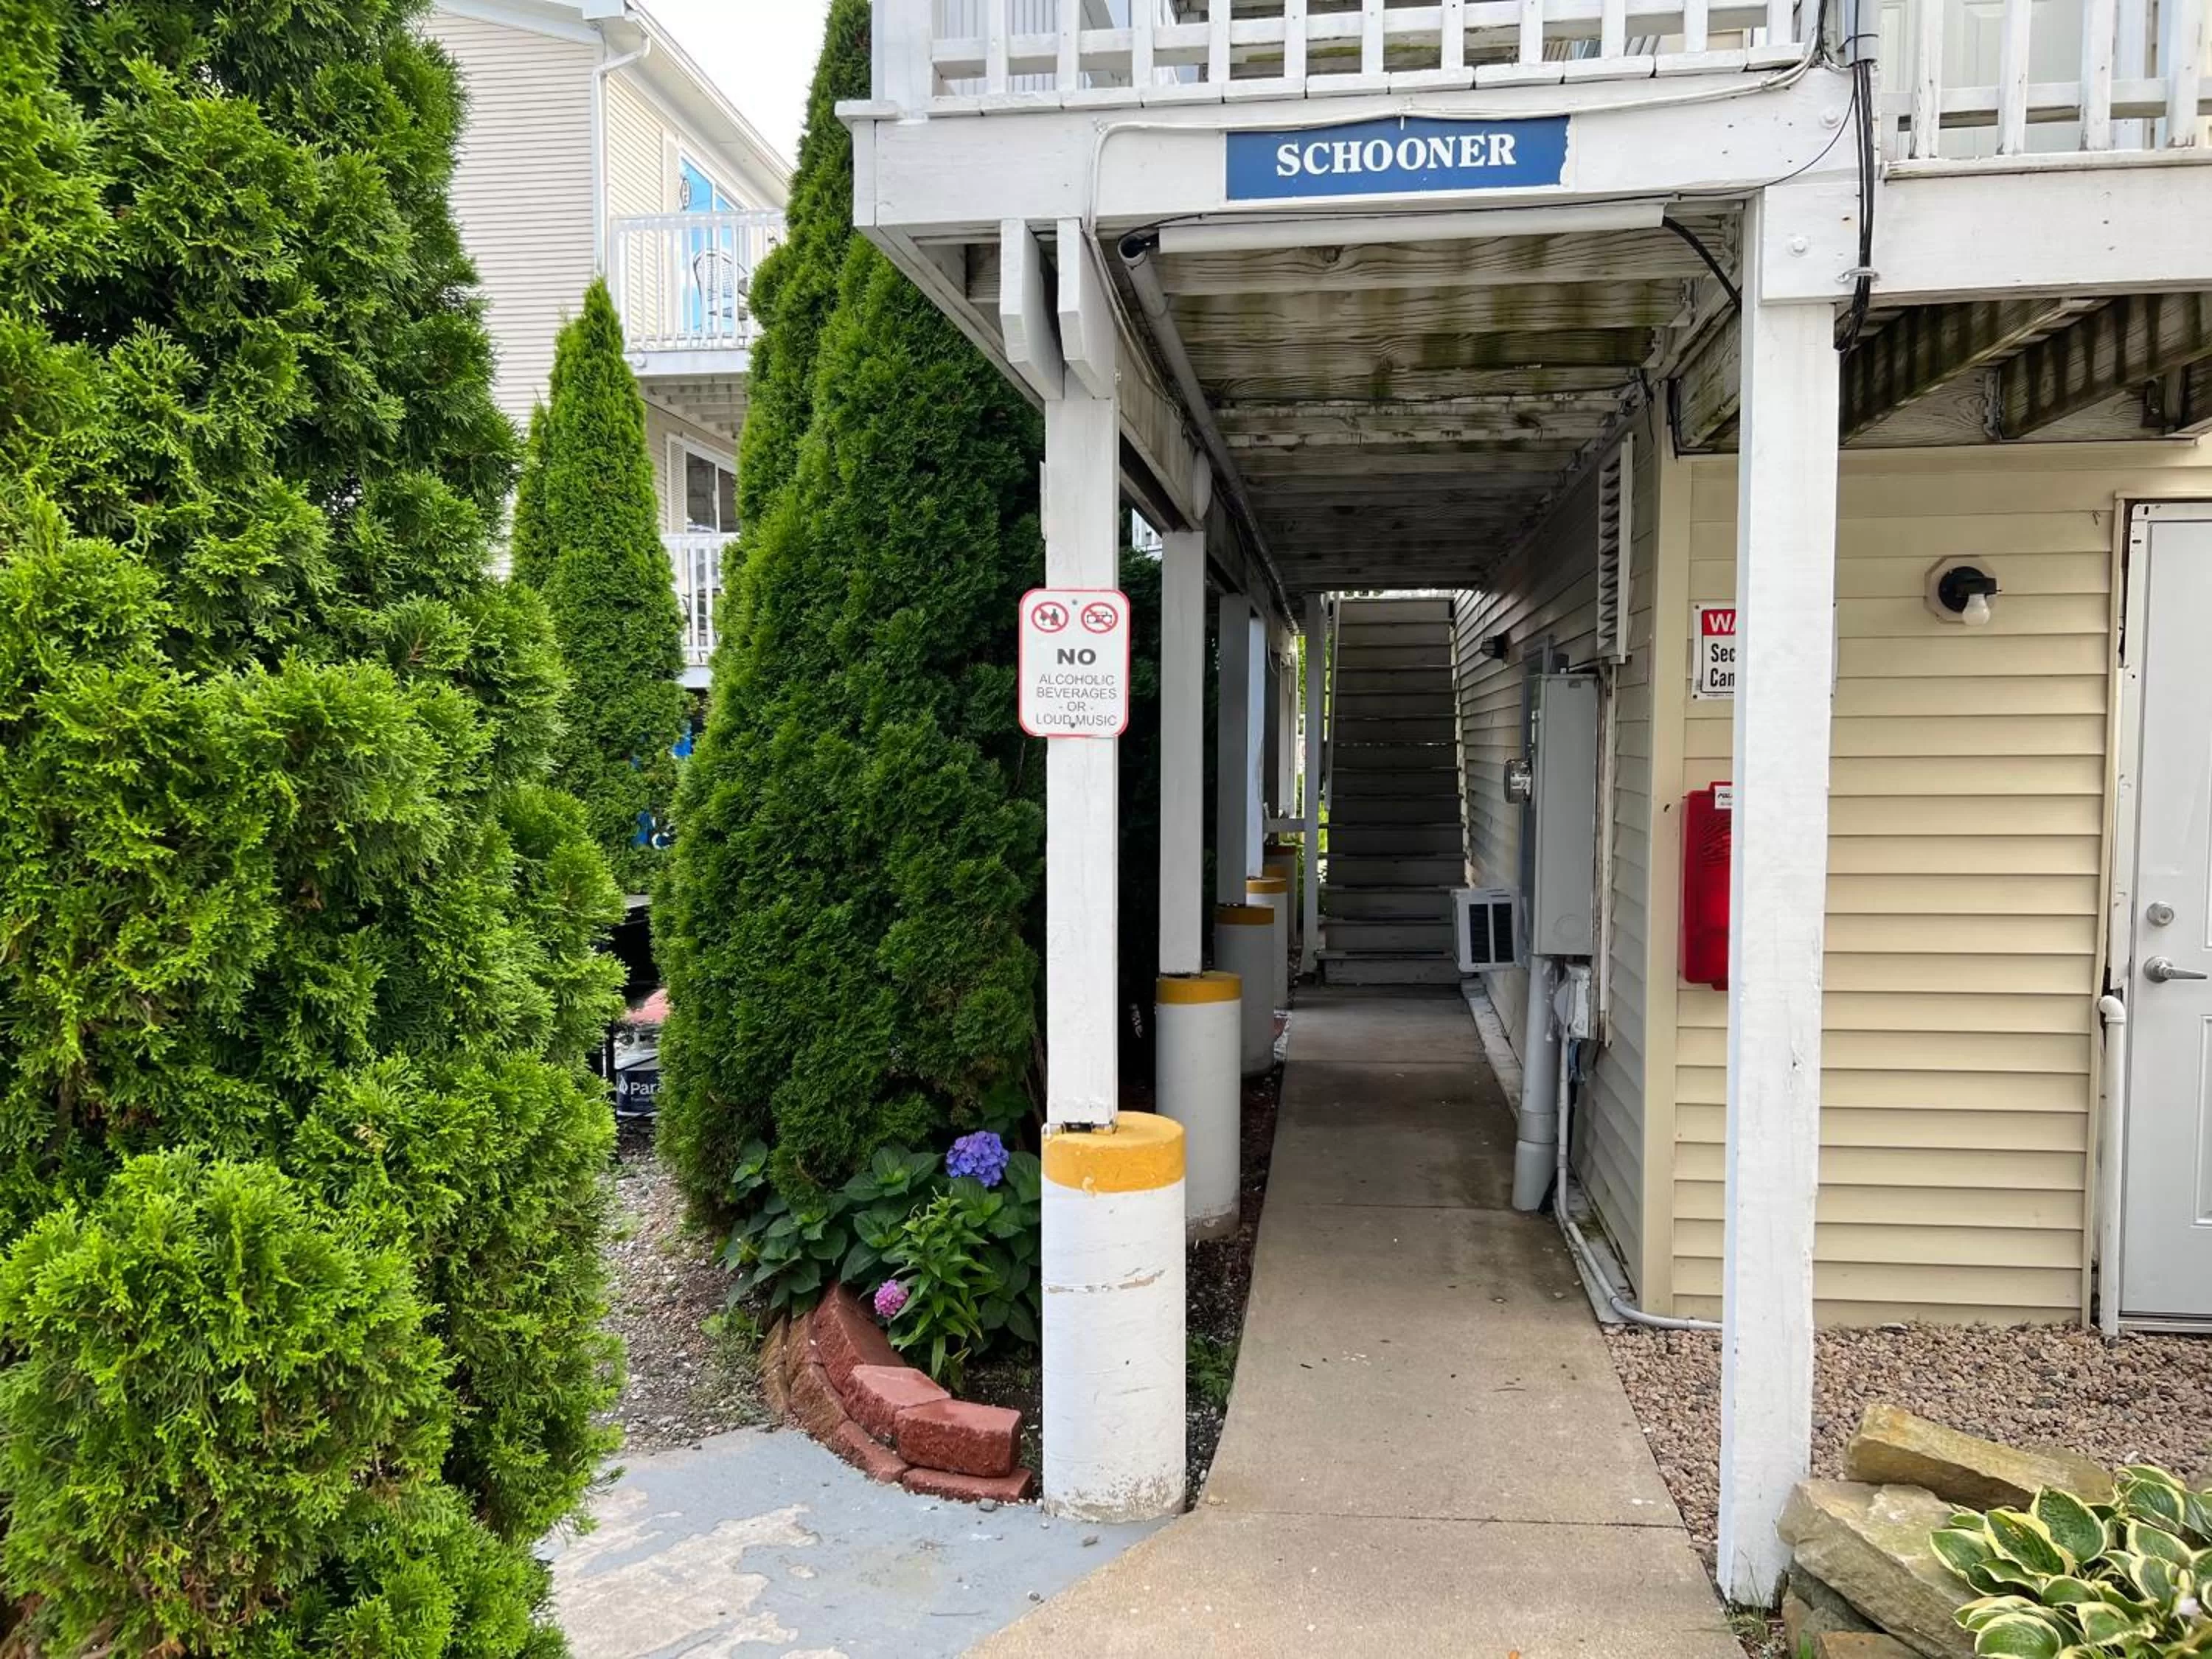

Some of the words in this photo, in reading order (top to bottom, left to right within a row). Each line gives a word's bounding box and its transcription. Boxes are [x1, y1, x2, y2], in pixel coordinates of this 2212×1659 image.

[1276, 133, 1517, 177] SCHOONER
[1057, 648, 1096, 665] NO
[1039, 673, 1115, 686] ALCOHOLIC
[1036, 686, 1117, 700] BEVERAGES
[1067, 701, 1086, 712] OR
[1036, 713, 1072, 726] LOUD
[1076, 714, 1118, 726] MUSIC
